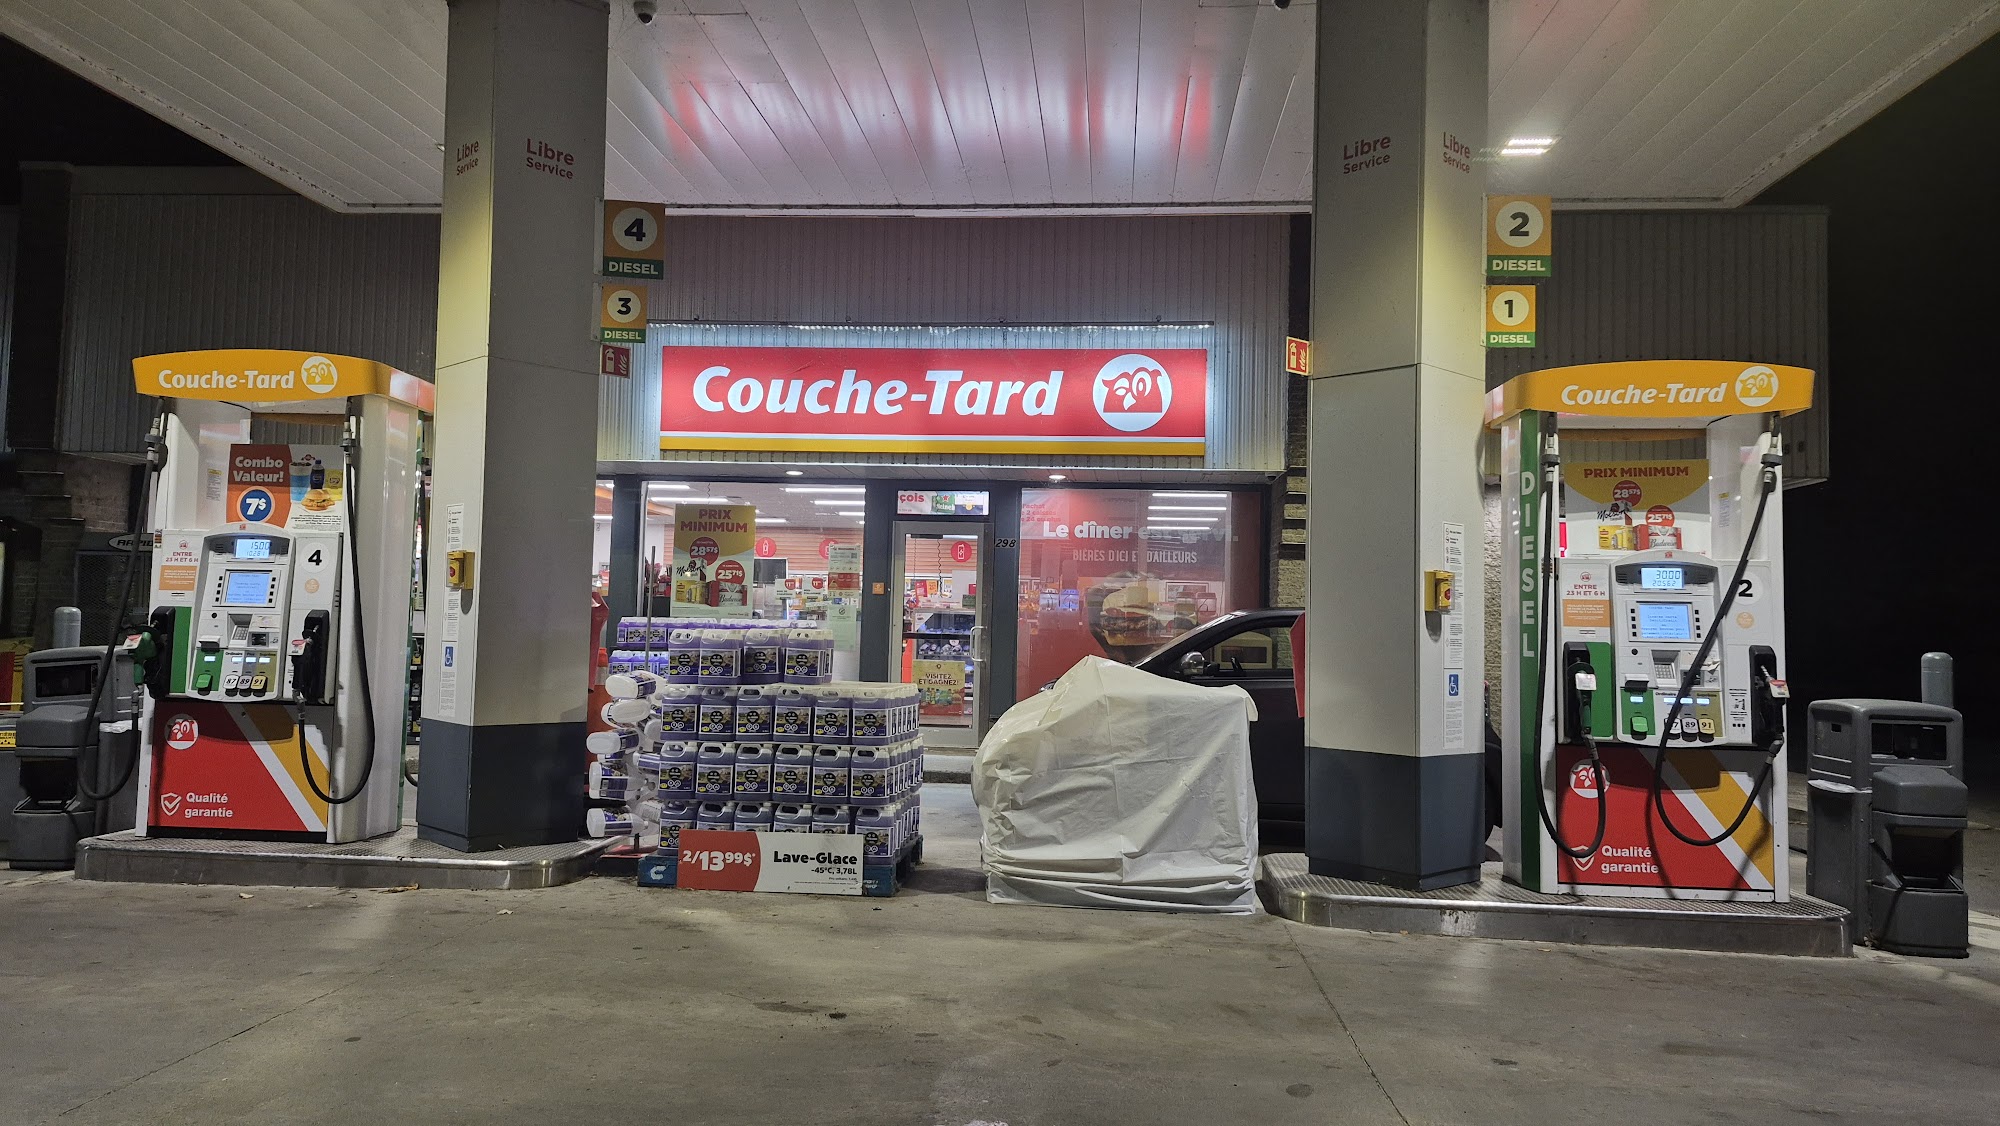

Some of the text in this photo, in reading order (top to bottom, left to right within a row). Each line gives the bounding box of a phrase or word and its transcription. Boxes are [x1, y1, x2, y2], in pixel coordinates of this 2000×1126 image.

[456, 140, 479, 163] Libre
[526, 138, 574, 166] Libre
[1343, 136, 1391, 160] Libre
[1443, 131, 1471, 159] Libre
[456, 156, 480, 177] Service
[526, 157, 574, 179] Service
[1343, 154, 1391, 175] Service
[1443, 152, 1471, 174] Service
[623, 218, 646, 242] 4
[1509, 212, 1530, 237] 2
[608, 261, 659, 276] DIESEL
[1492, 260, 1546, 271] DIESEL
[616, 298, 632, 316] 3
[1504, 299, 1514, 318] 1
[604, 330, 642, 340] DIESEL
[1490, 334, 1531, 344] DIESEL
[158, 369, 295, 389] Couche-Tard
[693, 365, 1064, 416] Couche-Tard
[1561, 382, 1728, 406] Couche-Tard
[235, 457, 284, 468] Combo
[233, 471, 284, 483] Valeur!
[1584, 466, 1689, 478] PRIX MINIMUM
[245, 498, 266, 515] 7$
[699, 509, 732, 520] PRIX
[680, 521, 748, 533] MINIMUM
[1043, 521, 1069, 538] Le
[1074, 520, 1133, 540] dîner
[995, 539, 1016, 548] 298
[307, 549, 323, 566] 4
[1073, 547, 1197, 563] BIÈRES D'ICI E D'AILLEURS
[1521, 471, 1536, 658] DIESEL
[1738, 579, 1753, 597] 2
[186, 791, 228, 804] Qualité
[185, 807, 233, 818] garantie
[773, 850, 858, 866] Lave-Glace
[1602, 844, 1652, 858] Qualité
[836, 867, 858, 875] 3,78L
[1601, 862, 1659, 873] garantie
